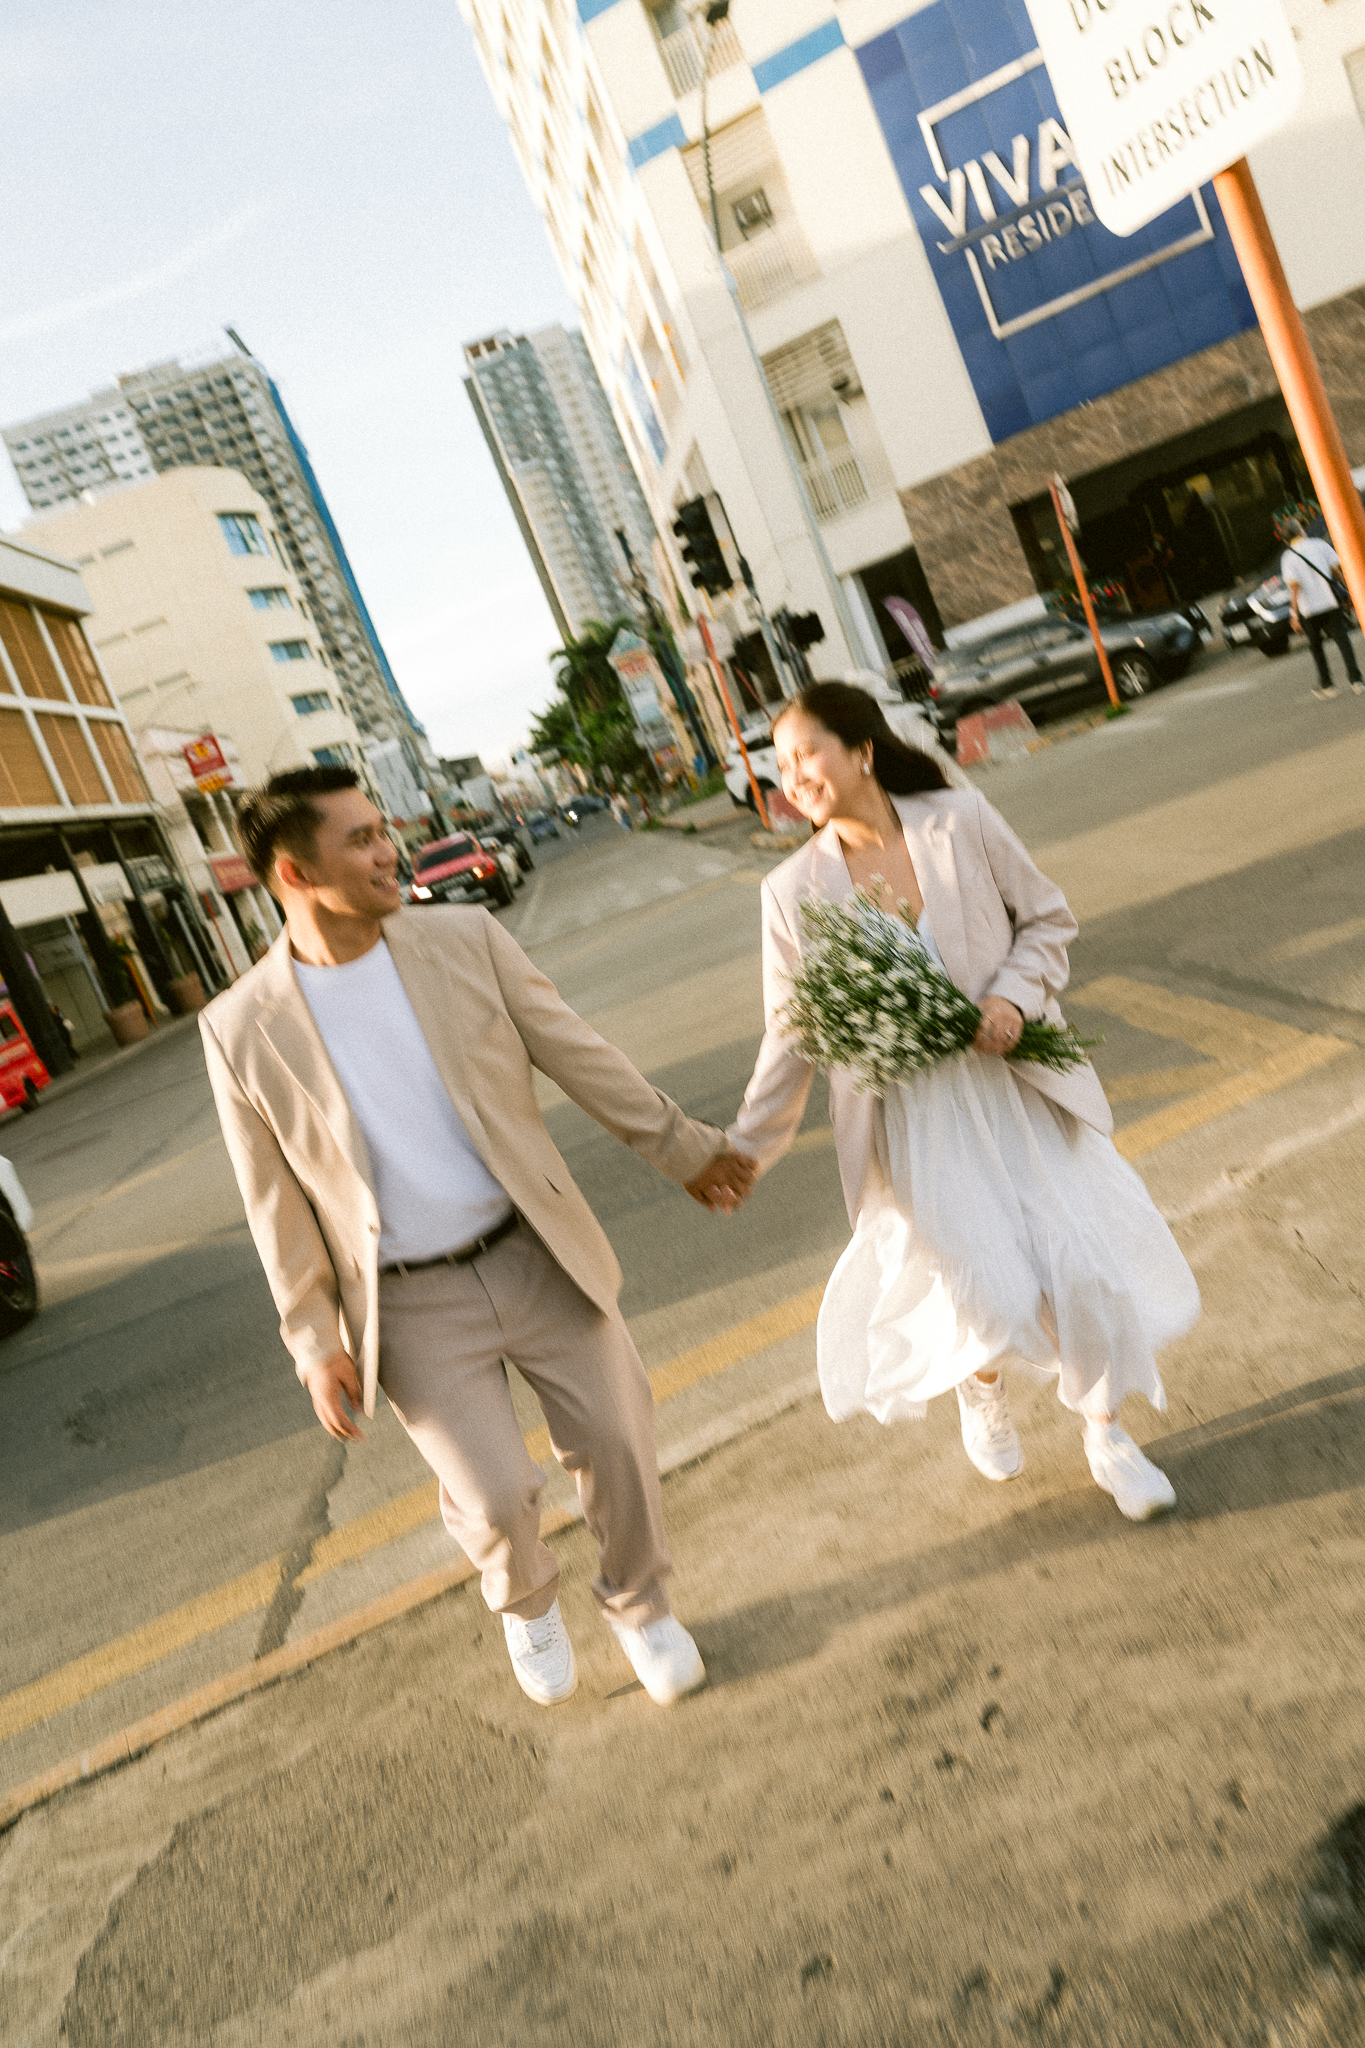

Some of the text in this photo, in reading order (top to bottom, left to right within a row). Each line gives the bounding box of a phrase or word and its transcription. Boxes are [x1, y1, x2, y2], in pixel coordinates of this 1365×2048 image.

[1104, 0, 1216, 98] BLOCK
[918, 117, 1084, 239] VIVA
[1101, 37, 1276, 199] INTERSECTION
